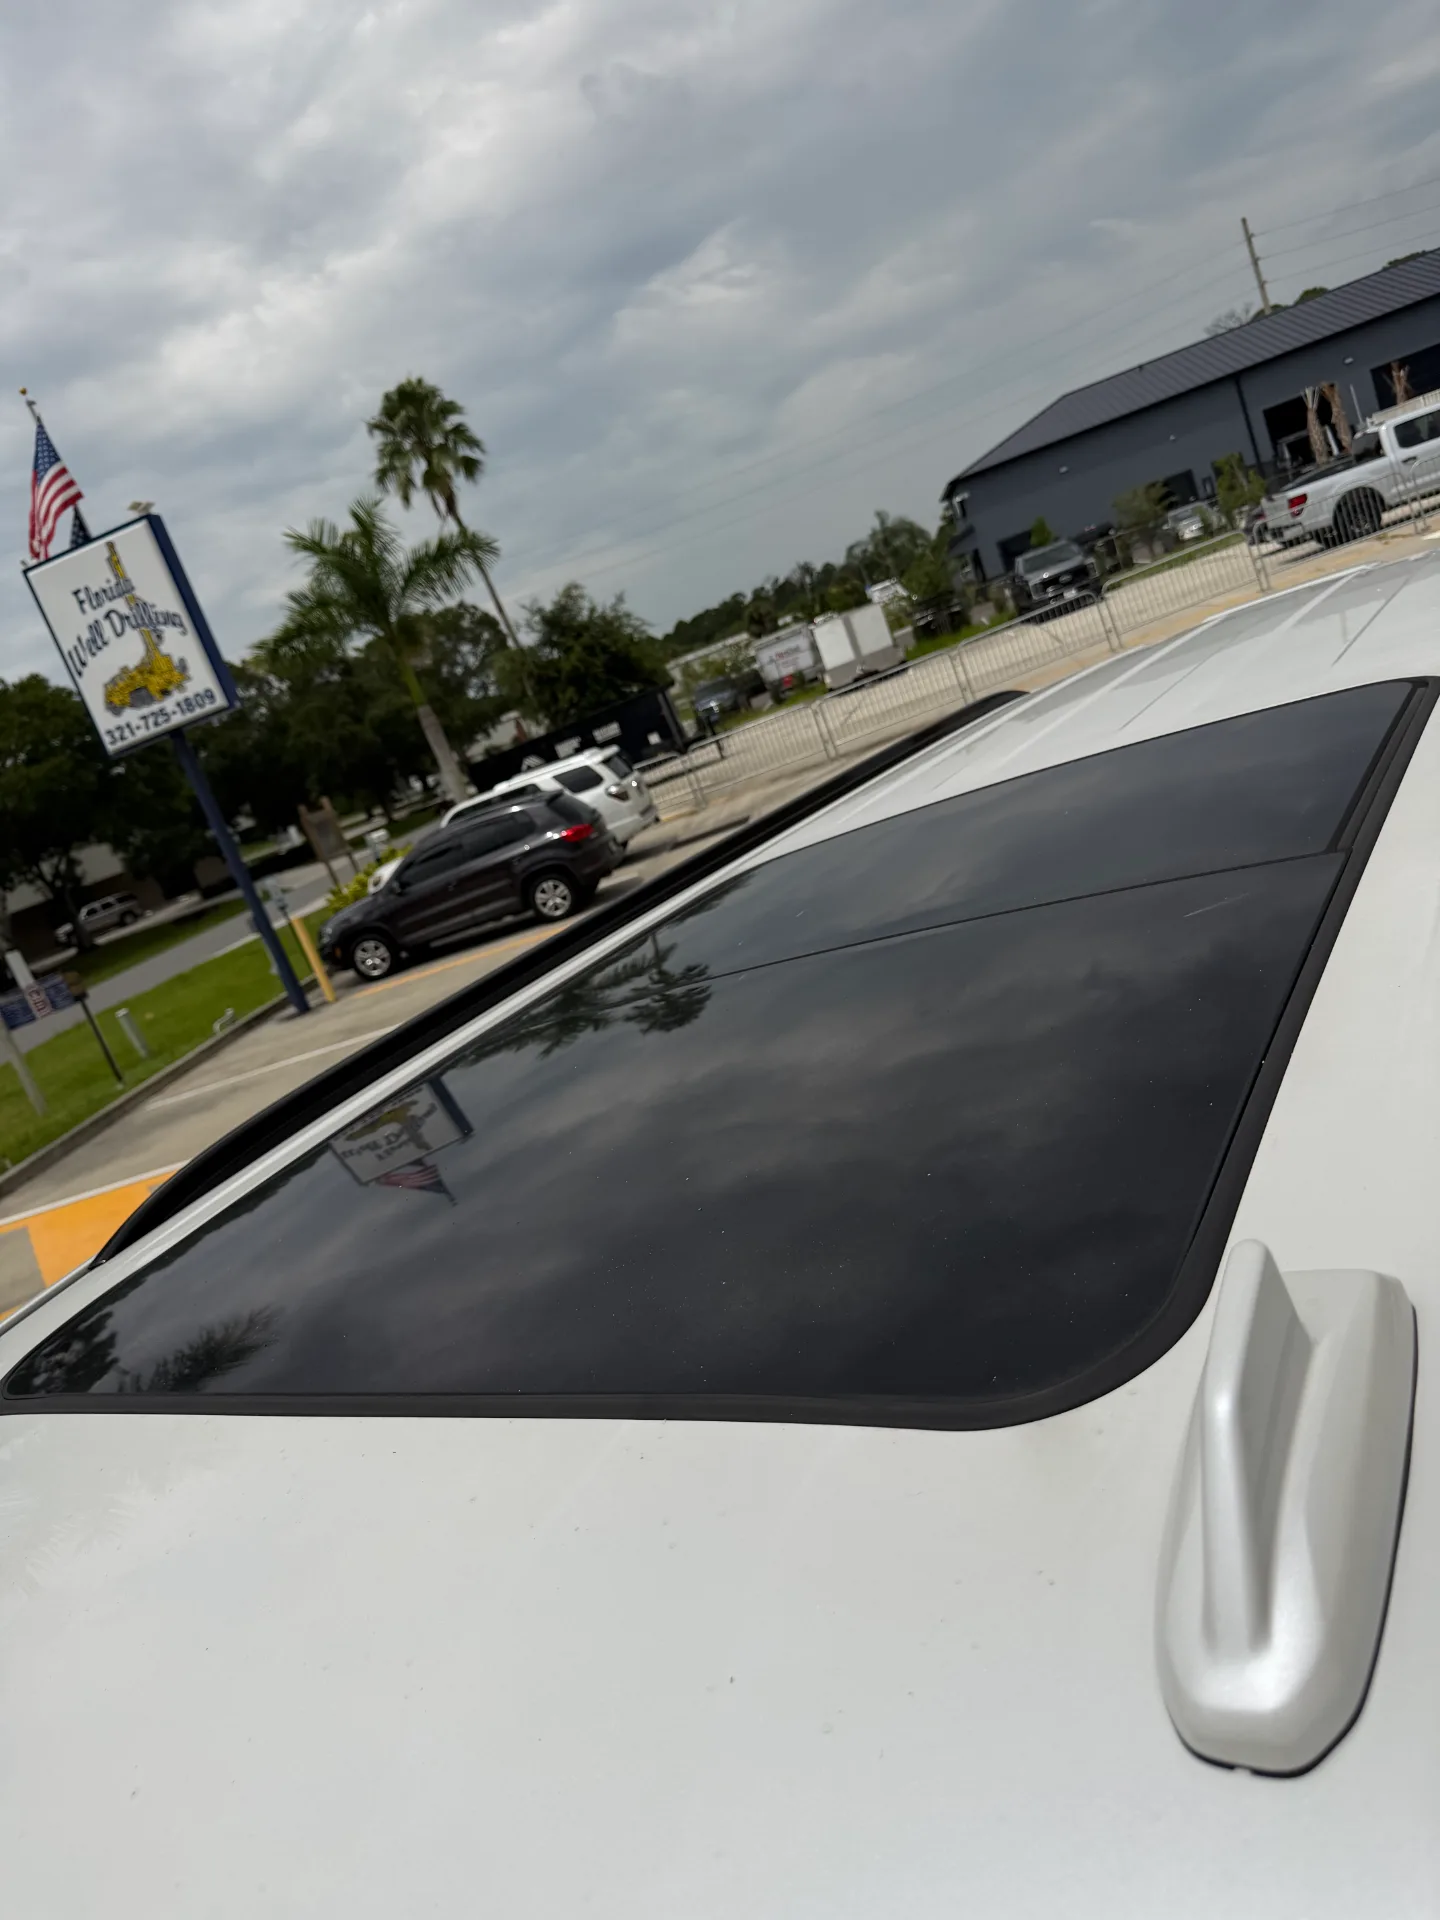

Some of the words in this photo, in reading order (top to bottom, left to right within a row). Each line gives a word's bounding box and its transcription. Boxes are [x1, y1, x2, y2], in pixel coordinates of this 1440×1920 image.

[72, 577, 135, 615] Florida
[67, 618, 110, 679] Well
[104, 601, 188, 637] Drilling
[105, 688, 217, 746] 321-725-1809
